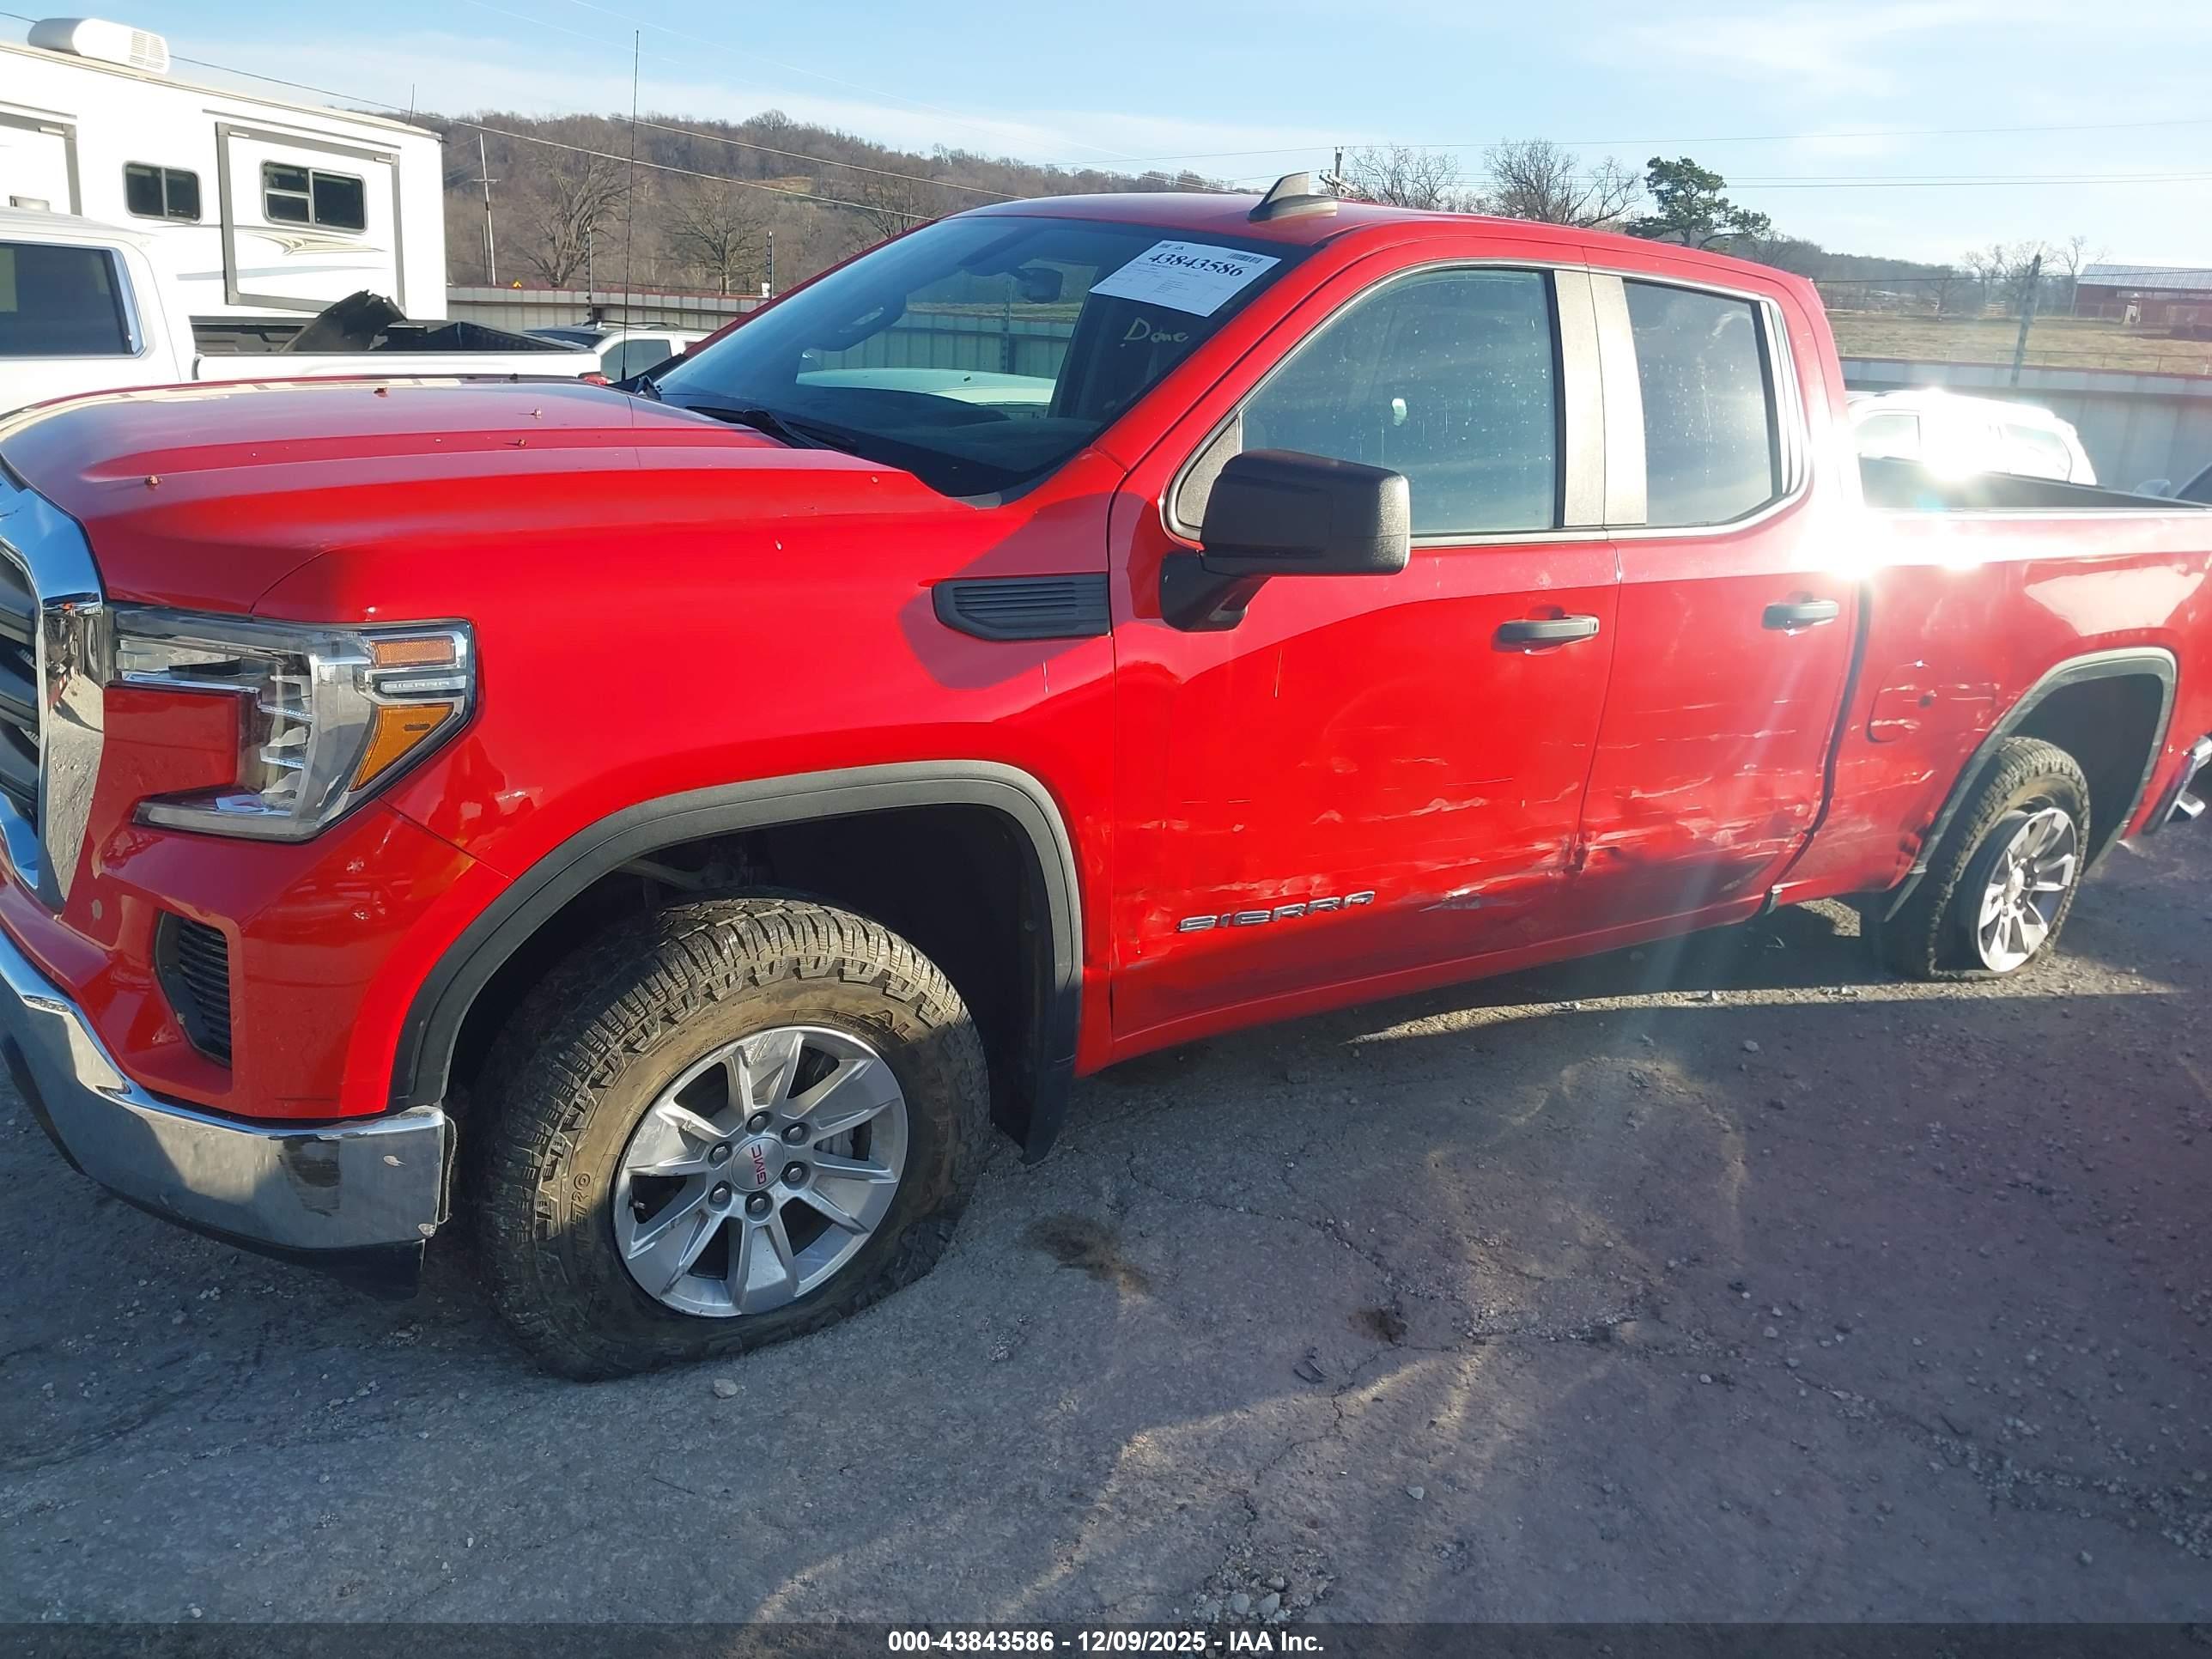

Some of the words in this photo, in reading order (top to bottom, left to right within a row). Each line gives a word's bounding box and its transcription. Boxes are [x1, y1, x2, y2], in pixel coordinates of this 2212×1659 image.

[1149, 252, 1250, 277] 43843586
[1124, 317, 1189, 343] Done
[385, 681, 451, 690] SIERRA
[1177, 890, 1376, 933] SIERRA
[751, 1144, 767, 1185] GMC
